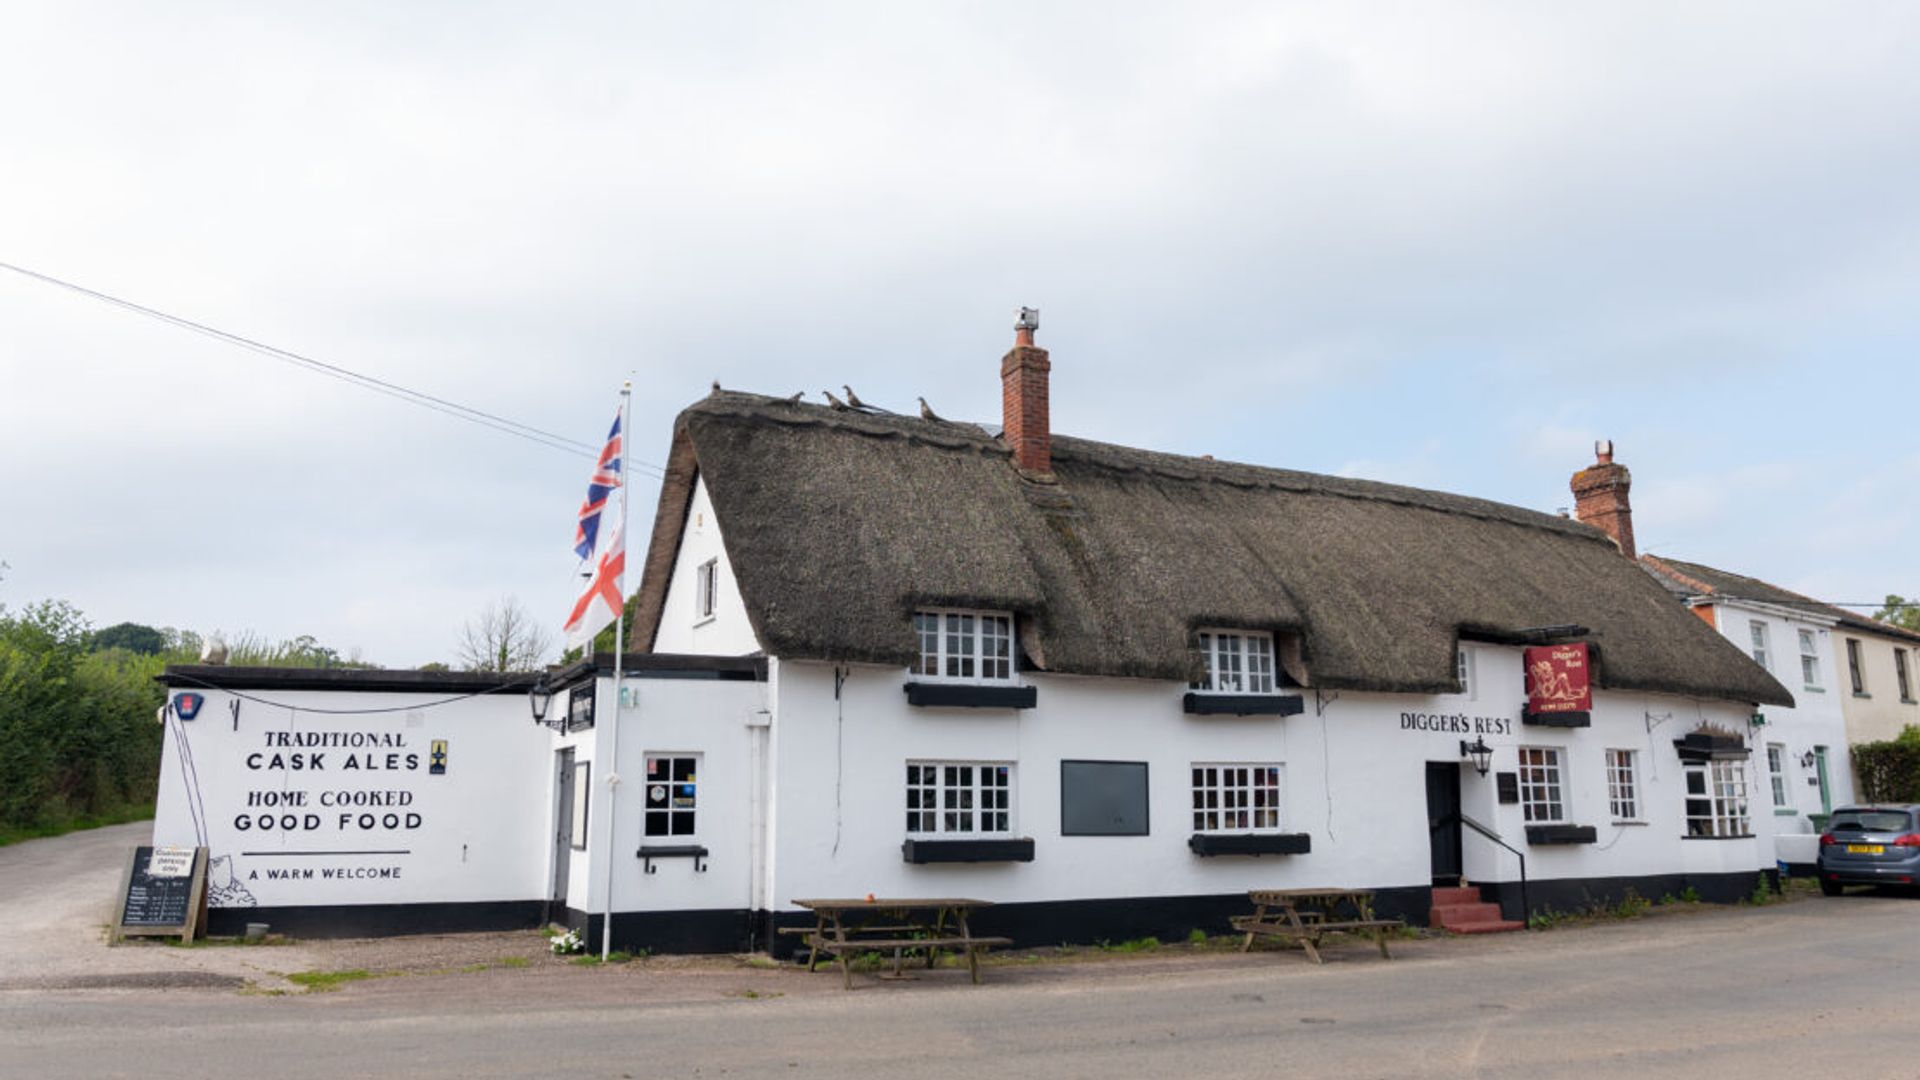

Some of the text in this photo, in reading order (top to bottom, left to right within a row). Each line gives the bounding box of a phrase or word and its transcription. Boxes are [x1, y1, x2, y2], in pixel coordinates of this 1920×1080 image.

[1400, 712, 1512, 735] DIGGER'S REST
[265, 731, 407, 748] TRADITIONAL
[246, 753, 419, 770] CASK ALES
[247, 790, 413, 807] HOME COOKED
[233, 813, 422, 831] GOOD FOOD
[249, 867, 402, 880] A WARM WELCOME
